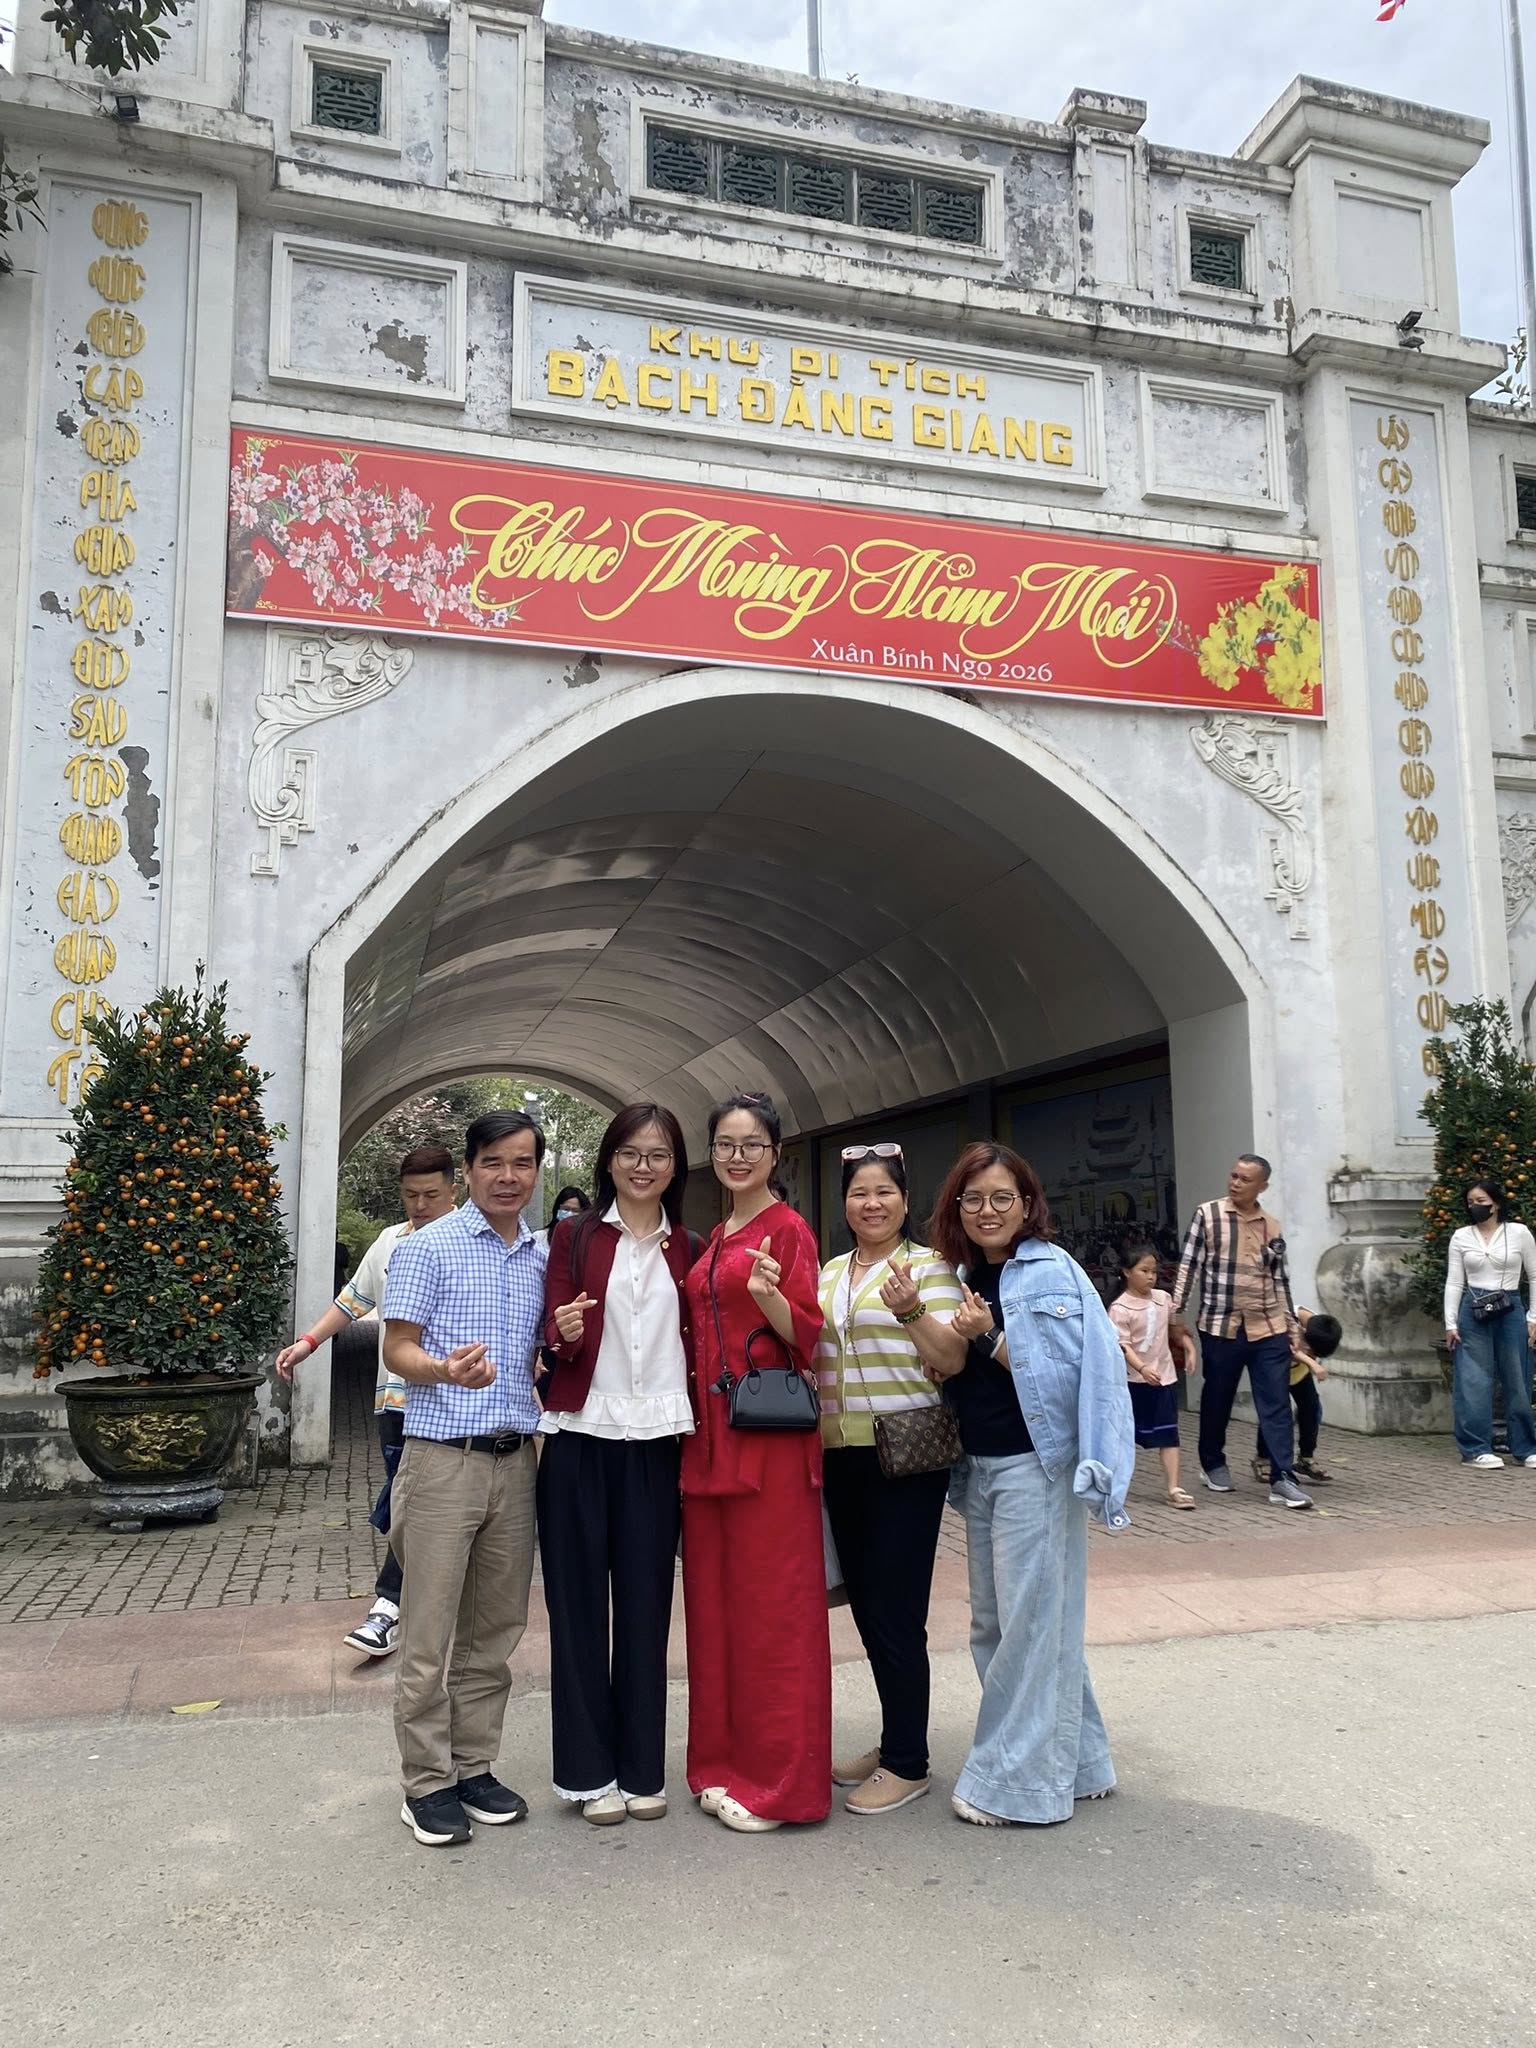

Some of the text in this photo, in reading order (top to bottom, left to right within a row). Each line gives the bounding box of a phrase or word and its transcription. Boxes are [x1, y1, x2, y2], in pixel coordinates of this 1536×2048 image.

[88, 254, 146, 303] NƯỚC
[648, 324, 986, 400] KHU DI TÍCH
[547, 347, 1074, 466] BẠCH ĐẰNG GIANG
[81, 416, 140, 465] TRẬN
[1376, 413, 1410, 451] LẤY
[1377, 456, 1413, 494] CÂY
[450, 493, 630, 610] Chúc
[577, 507, 850, 640] Mừng
[959, 562, 1178, 668] Mới
[74, 585, 134, 634] XÂM
[71, 635, 130, 690] ĐỜI
[810, 637, 1053, 682] Xuân Bính Ngọ 2026
[1391, 627, 1425, 667] CỌC
[69, 694, 128, 747] SAU
[64, 754, 126, 808] TÔN
[1399, 760, 1436, 800] QUÂN
[1405, 804, 1439, 846] XÂM
[57, 870, 120, 925] HẢI
[54, 930, 117, 985] QUÂN
